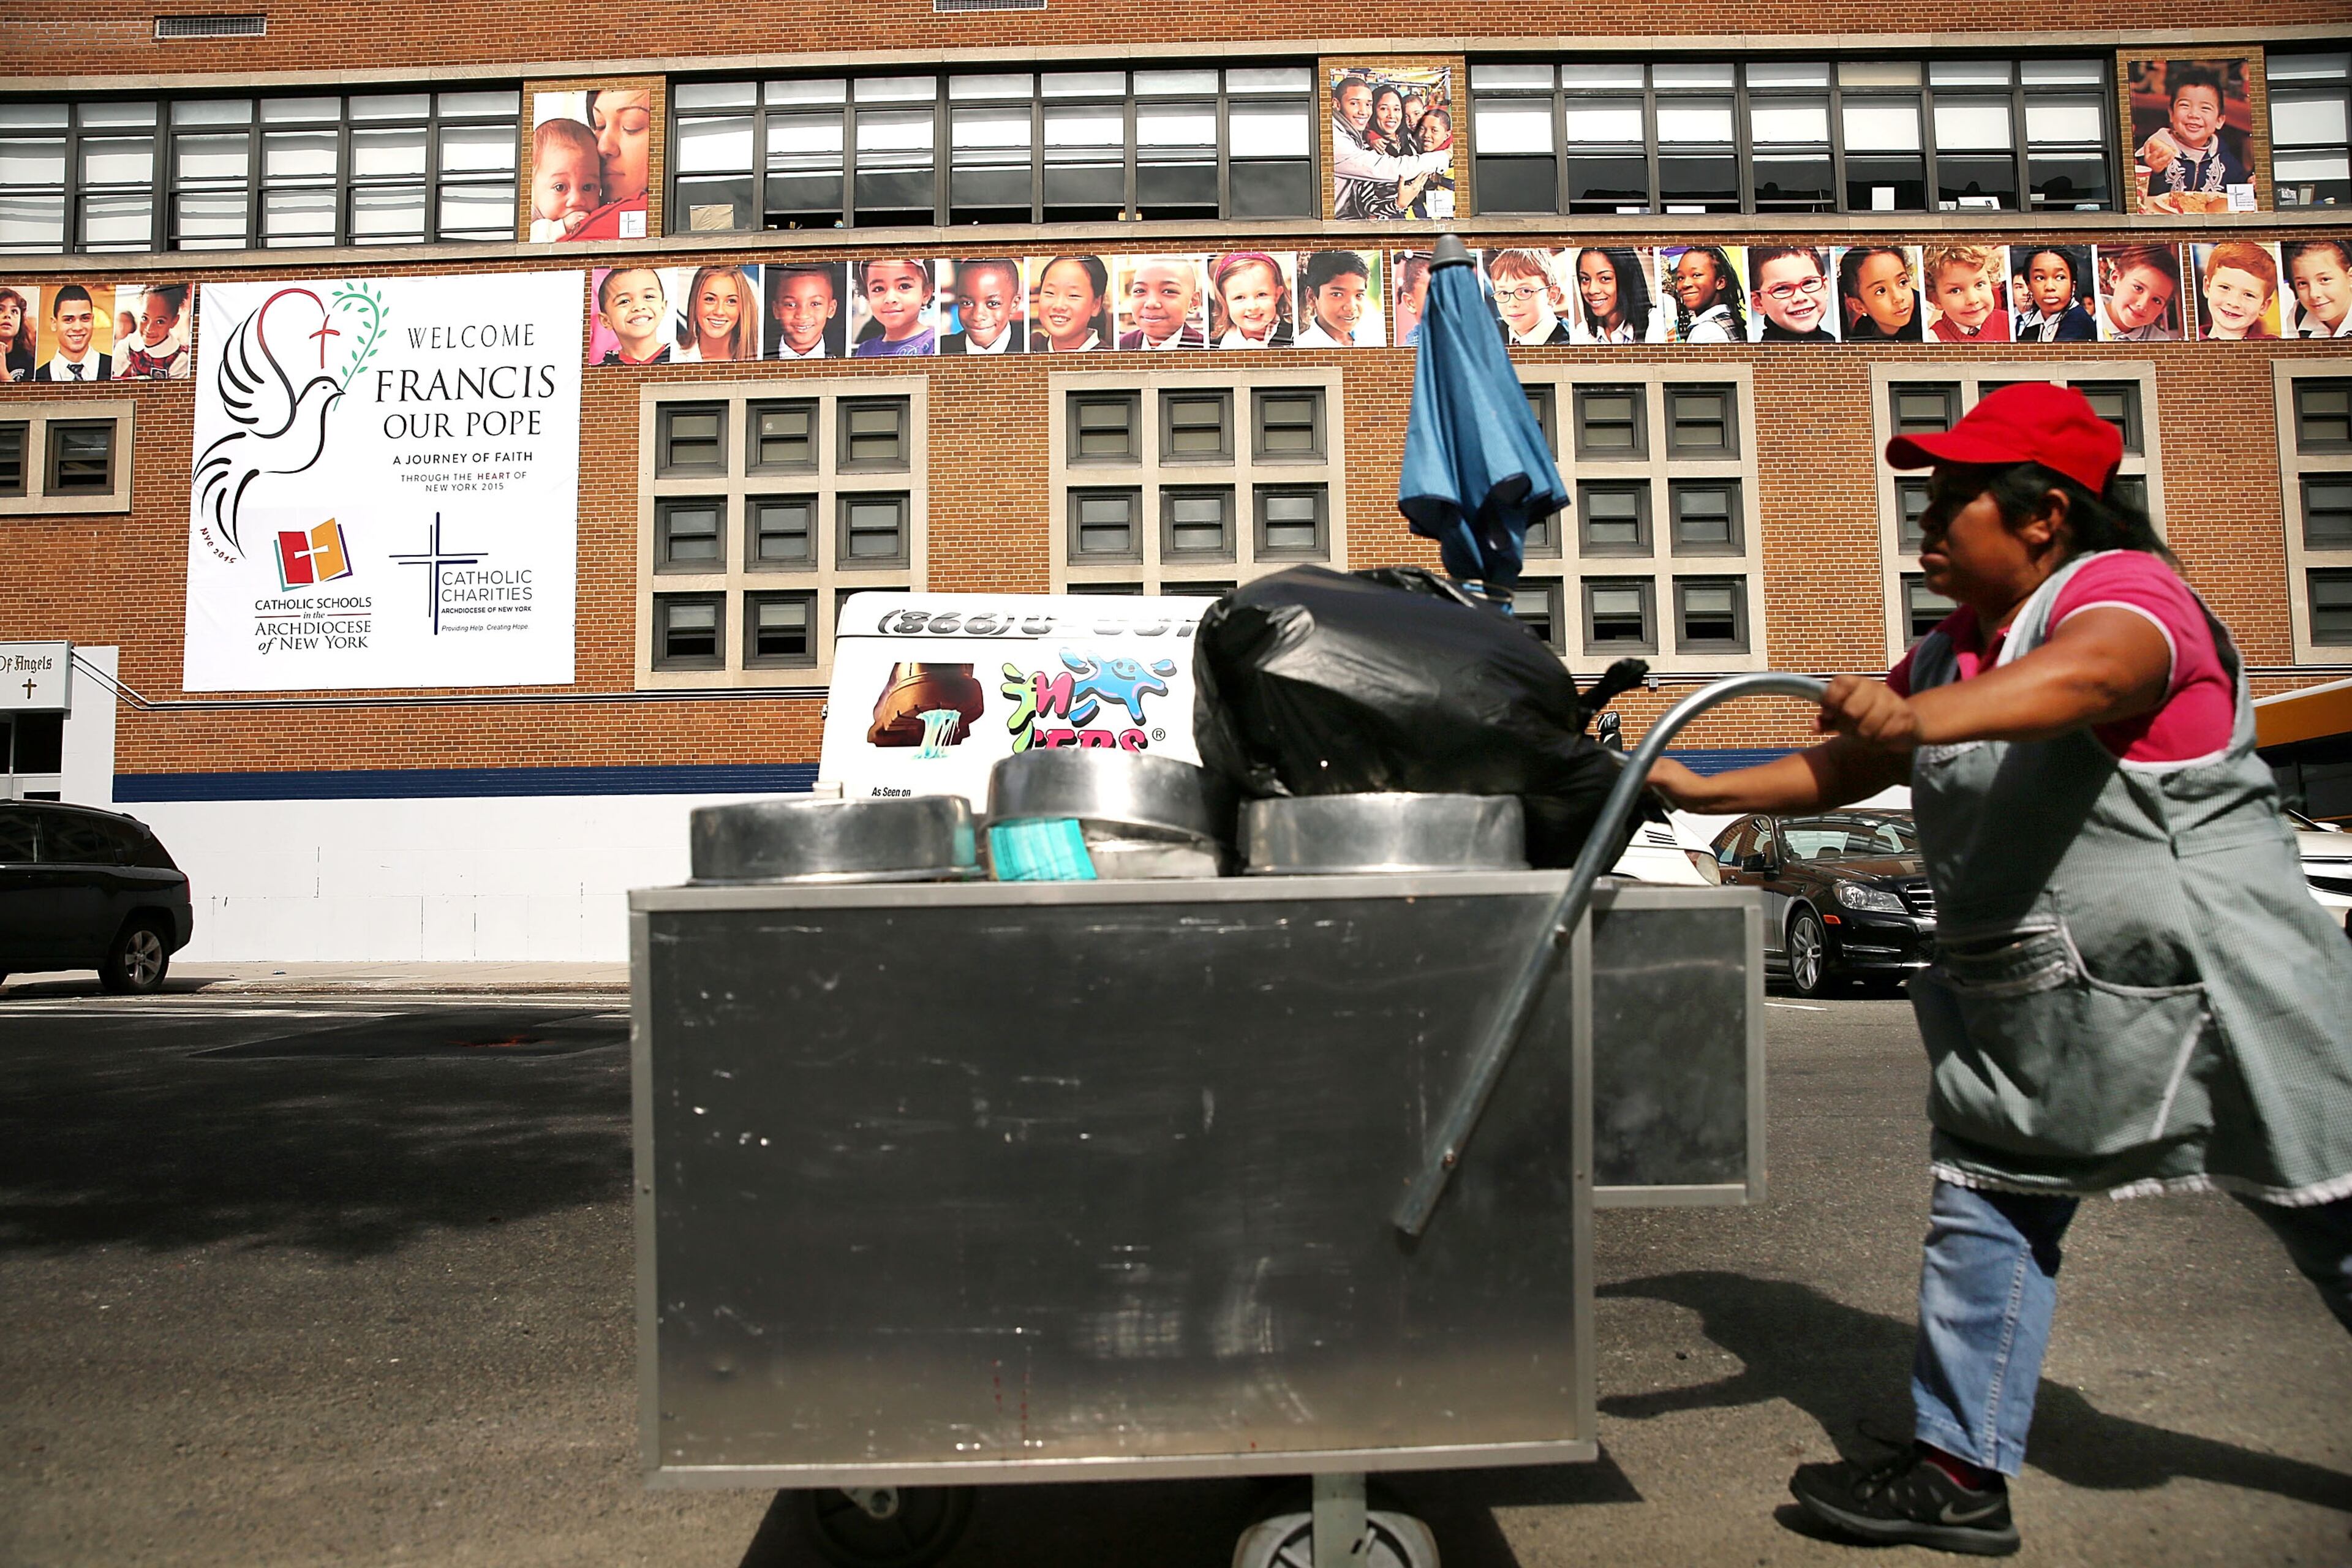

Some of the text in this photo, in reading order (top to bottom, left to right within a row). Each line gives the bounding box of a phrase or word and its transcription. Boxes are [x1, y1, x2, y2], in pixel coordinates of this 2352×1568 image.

[408, 323, 534, 349] WELCOME
[375, 365, 555, 402] FRANCIS
[384, 410, 540, 439] OUR POPE
[393, 451, 532, 464] A JOURNEY OF FAITH
[200, 527, 236, 564] NYC 2015
[442, 570, 532, 585] CATHOLIC
[442, 587, 532, 601] CHARITIES
[255, 597, 371, 610] CATHOLIC SCHOOLS
[255, 620, 371, 636] ARCHDIOCESE
[258, 636, 368, 655] of NEW YORK
[14, 655, 52, 674] Angels
[872, 787, 881, 796] As
[883, 787, 900, 797] Seen
